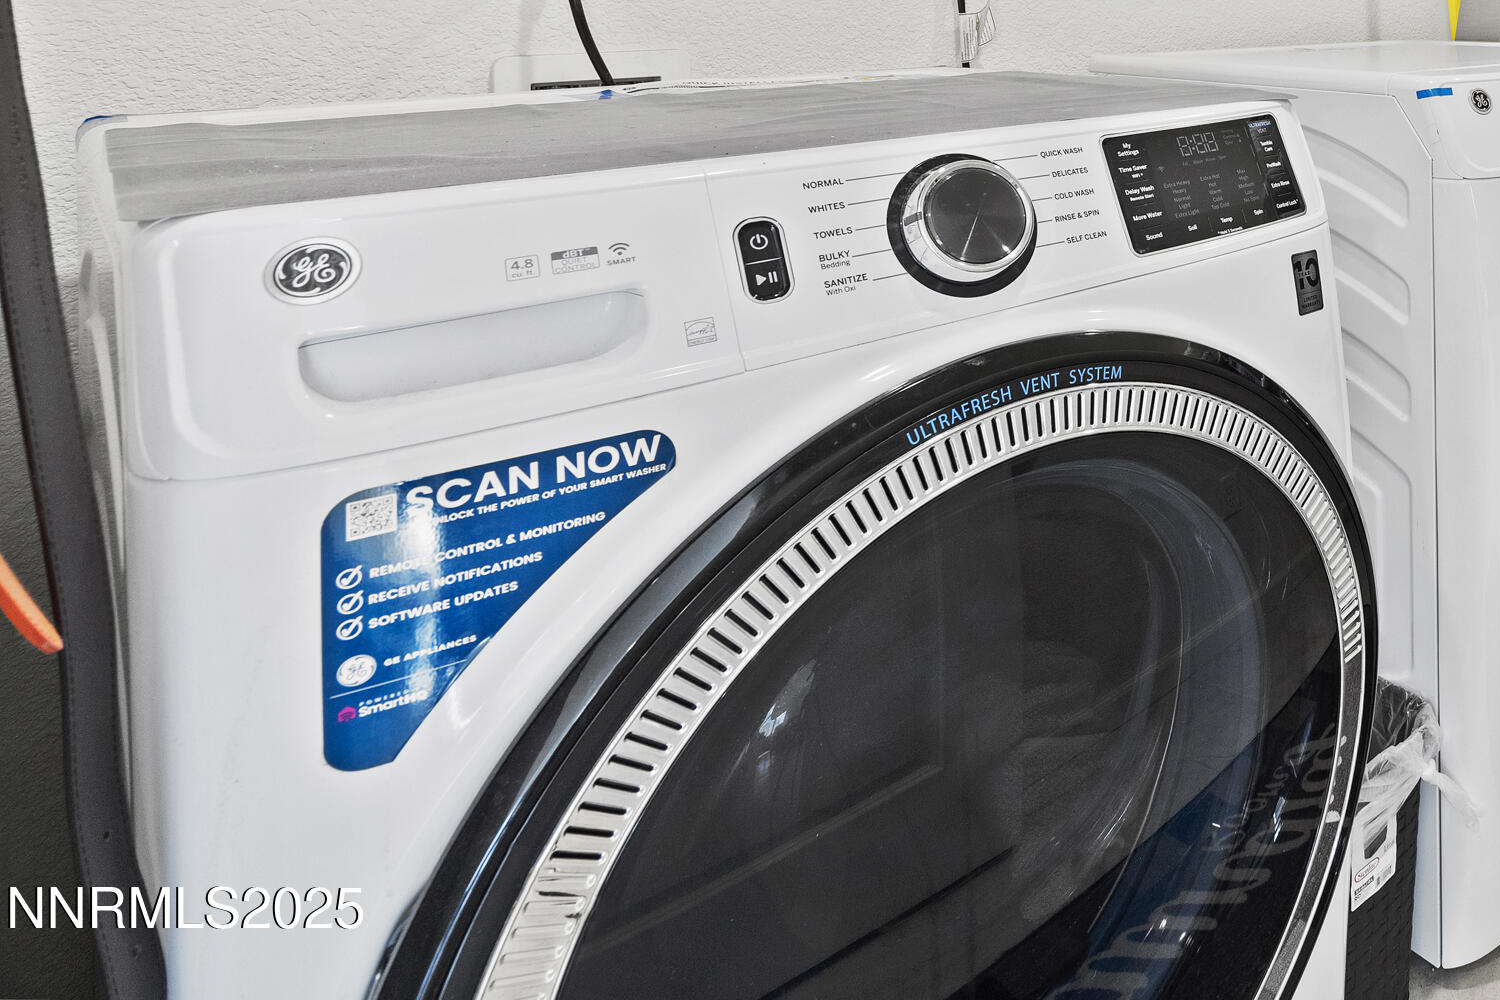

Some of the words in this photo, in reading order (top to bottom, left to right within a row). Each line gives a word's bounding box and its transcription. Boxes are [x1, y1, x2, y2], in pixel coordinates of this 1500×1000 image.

[1040, 150, 1060, 158] QUICK
[1062, 147, 1084, 156] WASH
[1052, 167, 1088, 178] DELICATES
[1118, 166, 1132, 174] Time
[803, 178, 844, 190] NORMAL
[1054, 191, 1074, 200] COLD
[1074, 188, 1095, 198] WASH
[1124, 188, 1140, 196] Delay
[808, 201, 846, 214] WHITES
[1188, 208, 1200, 216] Light
[1054, 213, 1076, 222] RINSE
[1084, 209, 1100, 218] SPIN
[814, 226, 853, 240] TOWELS
[1188, 224, 1198, 232] Soil
[1066, 236, 1085, 245] SELF
[1086, 230, 1108, 242] CLEAN
[1146, 232, 1163, 240] Sound
[561, 257, 587, 266] QUIET
[607, 256, 636, 266] SMART
[818, 250, 850, 263] BULKY
[510, 258, 534, 270] 4.8
[555, 262, 596, 274] CONTROL
[820, 260, 850, 270] Bedding
[1294, 258, 1318, 290] 10
[824, 272, 868, 289] SANITIZE
[826, 288, 844, 296] With
[844, 284, 856, 293] Oxi
[906, 386, 1012, 446] ULTRAFRESH
[1020, 372, 1060, 395] VENT
[1069, 366, 1122, 385] SYSTEM
[405, 461, 540, 510] SCAN
[556, 434, 661, 484] NOW
[432, 511, 474, 526] NLOCK
[478, 504, 498, 516] THE
[500, 494, 540, 510] POWER
[542, 490, 556, 500] OF
[558, 481, 588, 496] YOUR
[590, 473, 624, 488] SMART
[626, 462, 667, 480] WASHER
[435, 537, 503, 562] CONTROL
[506, 532, 517, 546] &
[519, 512, 606, 542] MONITORING
[368, 582, 430, 606] RECEIVE
[434, 552, 543, 588] NOTIFICATIONS
[368, 600, 451, 630] SOFTWARE
[454, 581, 518, 607] UPDATES
[384, 656, 400, 667] GE
[403, 634, 478, 662] APPLIANCES
